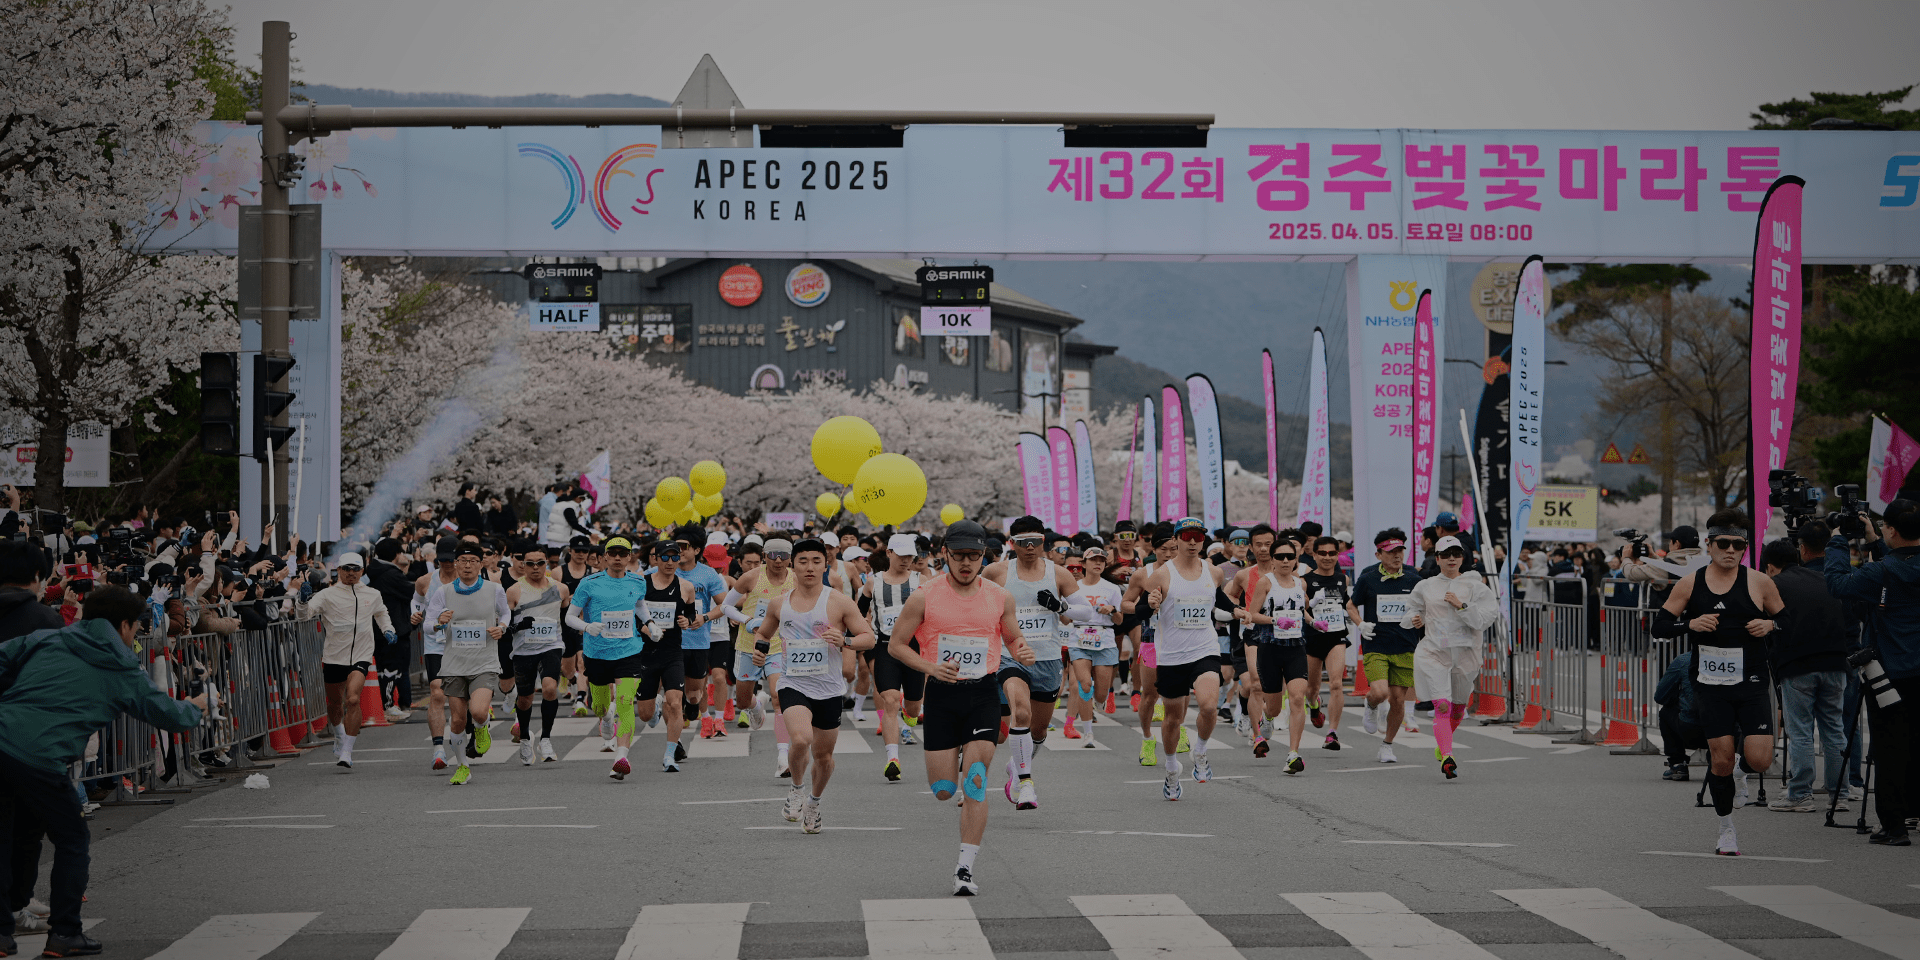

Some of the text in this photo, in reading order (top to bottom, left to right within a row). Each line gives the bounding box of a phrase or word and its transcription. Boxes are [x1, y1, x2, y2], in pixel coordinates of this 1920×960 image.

[694, 159, 888, 191] APEC 2025
[1047, 142, 1783, 212] 제32회 경주벚꽃마라톤
[694, 200, 806, 221] KOREA
[1406, 223, 1463, 242] 토요일
[1470, 224, 1533, 242] 08:00
[546, 267, 594, 277] SAMIK
[938, 270, 986, 280] SAMIK
[539, 309, 589, 322] HALF
[938, 313, 972, 327] 10K
[1381, 342, 1414, 355] APE
[1381, 363, 1414, 376] 202
[1519, 347, 1528, 444] APEC 2025
[1530, 390, 1539, 447] KOREA
[1543, 501, 1573, 517] 5K
[1180, 608, 1206, 618] 1122
[1381, 604, 1406, 613] 2774
[530, 626, 553, 635] 3167
[606, 620, 630, 629] 1978
[1017, 618, 1047, 630] 2517
[456, 630, 481, 639] 2116
[791, 652, 823, 663] 2270
[942, 650, 981, 665] 2093
[1703, 660, 1736, 673] 1645
